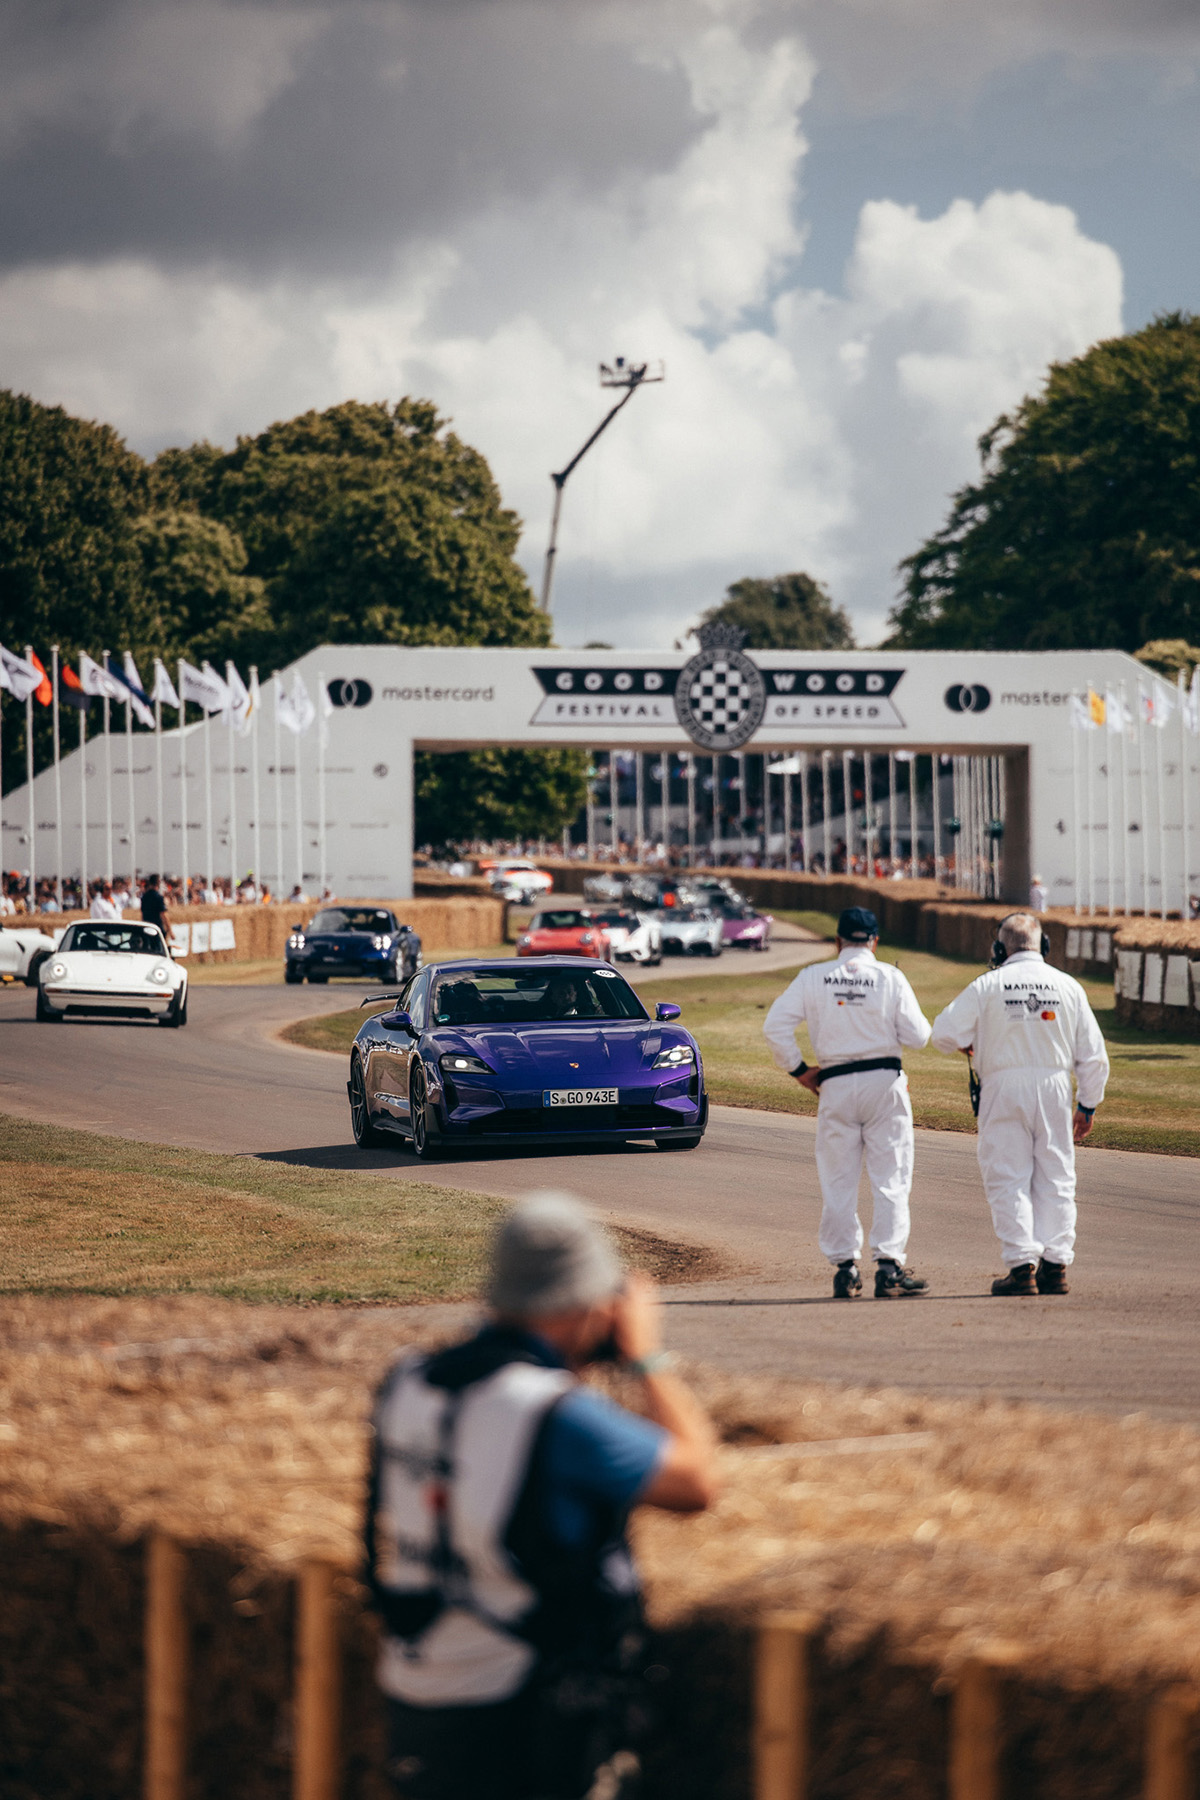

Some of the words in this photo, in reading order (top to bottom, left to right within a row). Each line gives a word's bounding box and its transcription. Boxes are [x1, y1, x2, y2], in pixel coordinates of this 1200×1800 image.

[555, 672, 664, 691] GOOD
[772, 673, 886, 692] WOOD
[382, 685, 495, 701] mastercard
[1000, 689, 1104, 706] master
[556, 703, 662, 716] FESTIVAL
[775, 704, 799, 718] OF
[814, 704, 880, 718] SPEED
[824, 977, 874, 988] MARSHAL
[1004, 983, 1057, 991] MARSHAL
[551, 1092, 560, 1105] S
[585, 1090, 616, 1104] 943E
